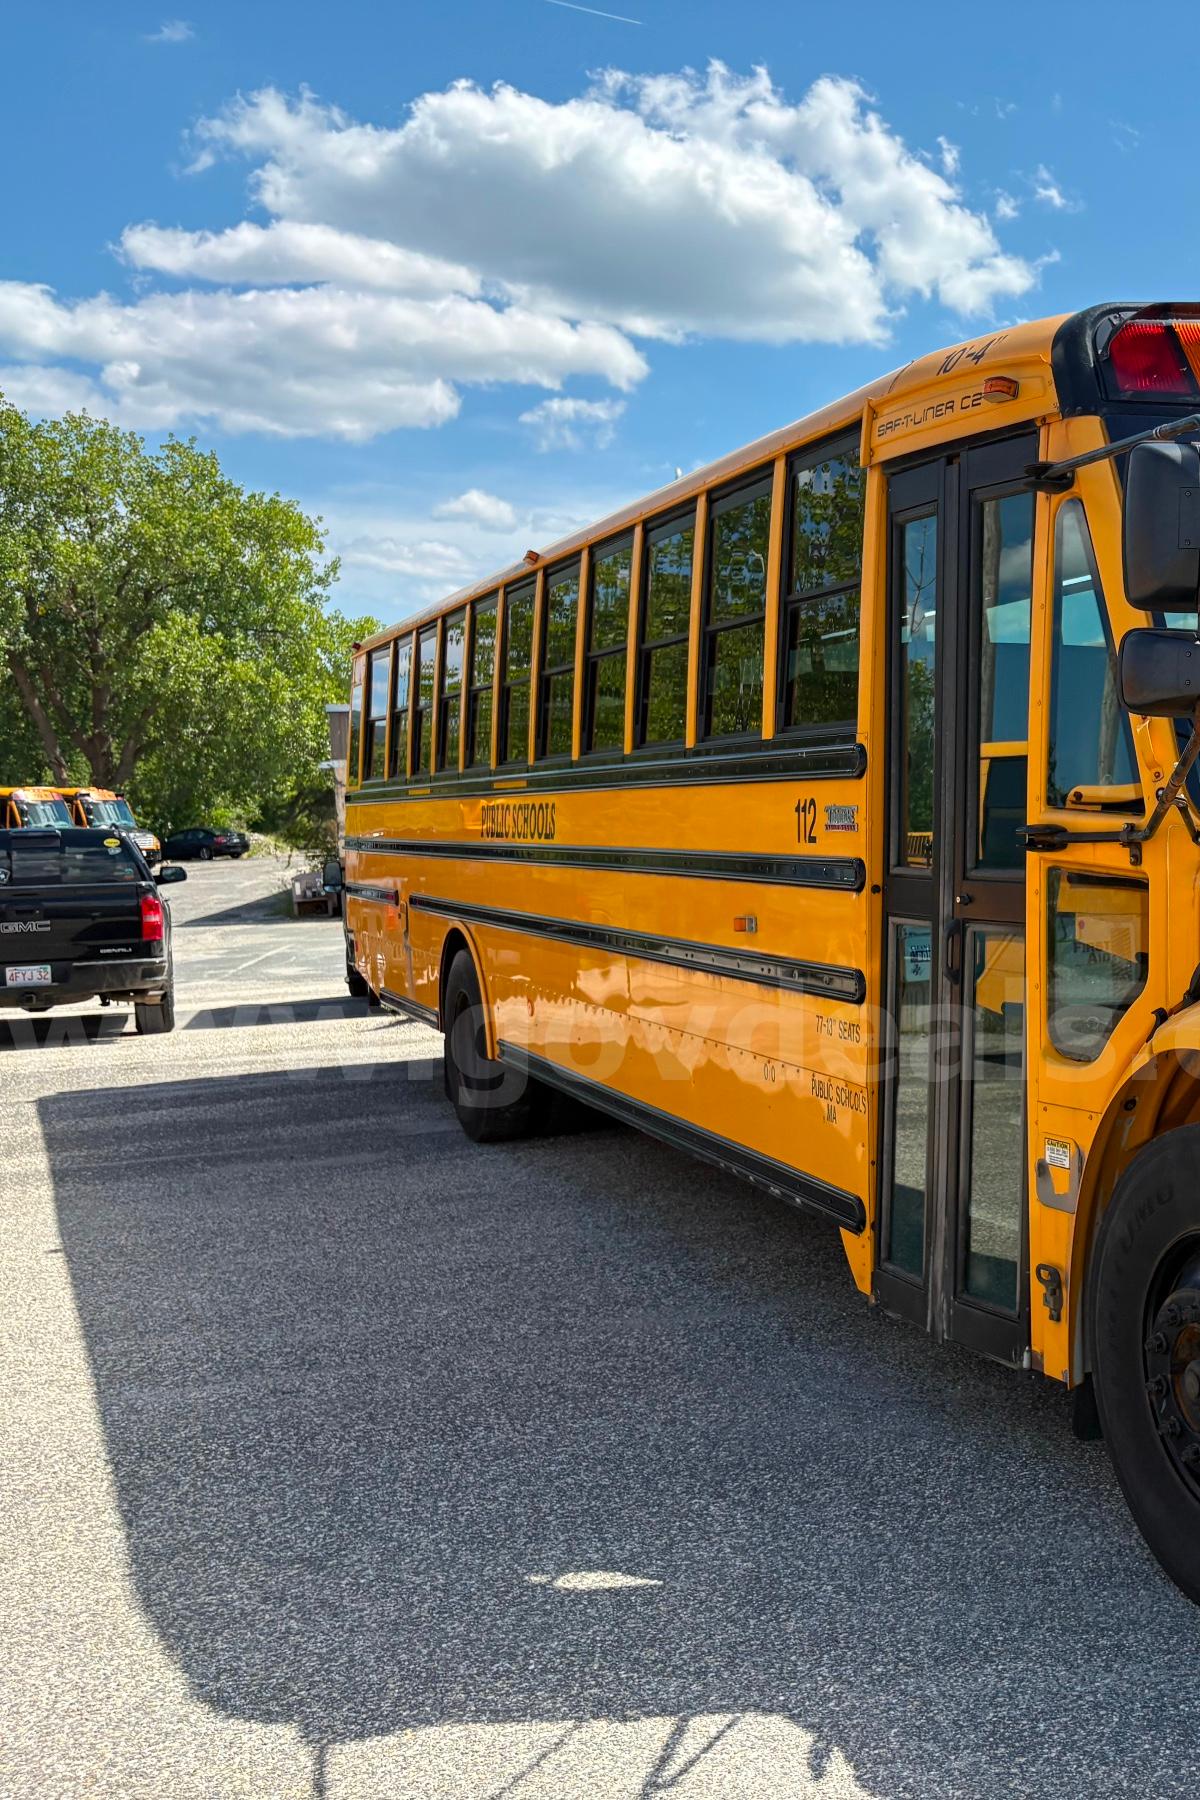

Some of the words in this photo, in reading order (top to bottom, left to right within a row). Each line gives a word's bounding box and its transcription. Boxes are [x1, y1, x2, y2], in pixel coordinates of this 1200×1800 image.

[877, 399, 955, 438] SAF-T-LINER
[959, 392, 984, 411] C2
[480, 803, 511, 839] PUBLIC
[512, 802, 556, 840] SCHOOLS
[795, 797, 817, 844] 112
[0, 920, 51, 933] GMC
[36, 970, 49, 981] 32
[838, 1020, 861, 1043] SEATS
[811, 1079, 834, 1102] PUBLIC
[836, 1086, 867, 1115] SCHOOLS
[826, 1104, 837, 1124] MA
